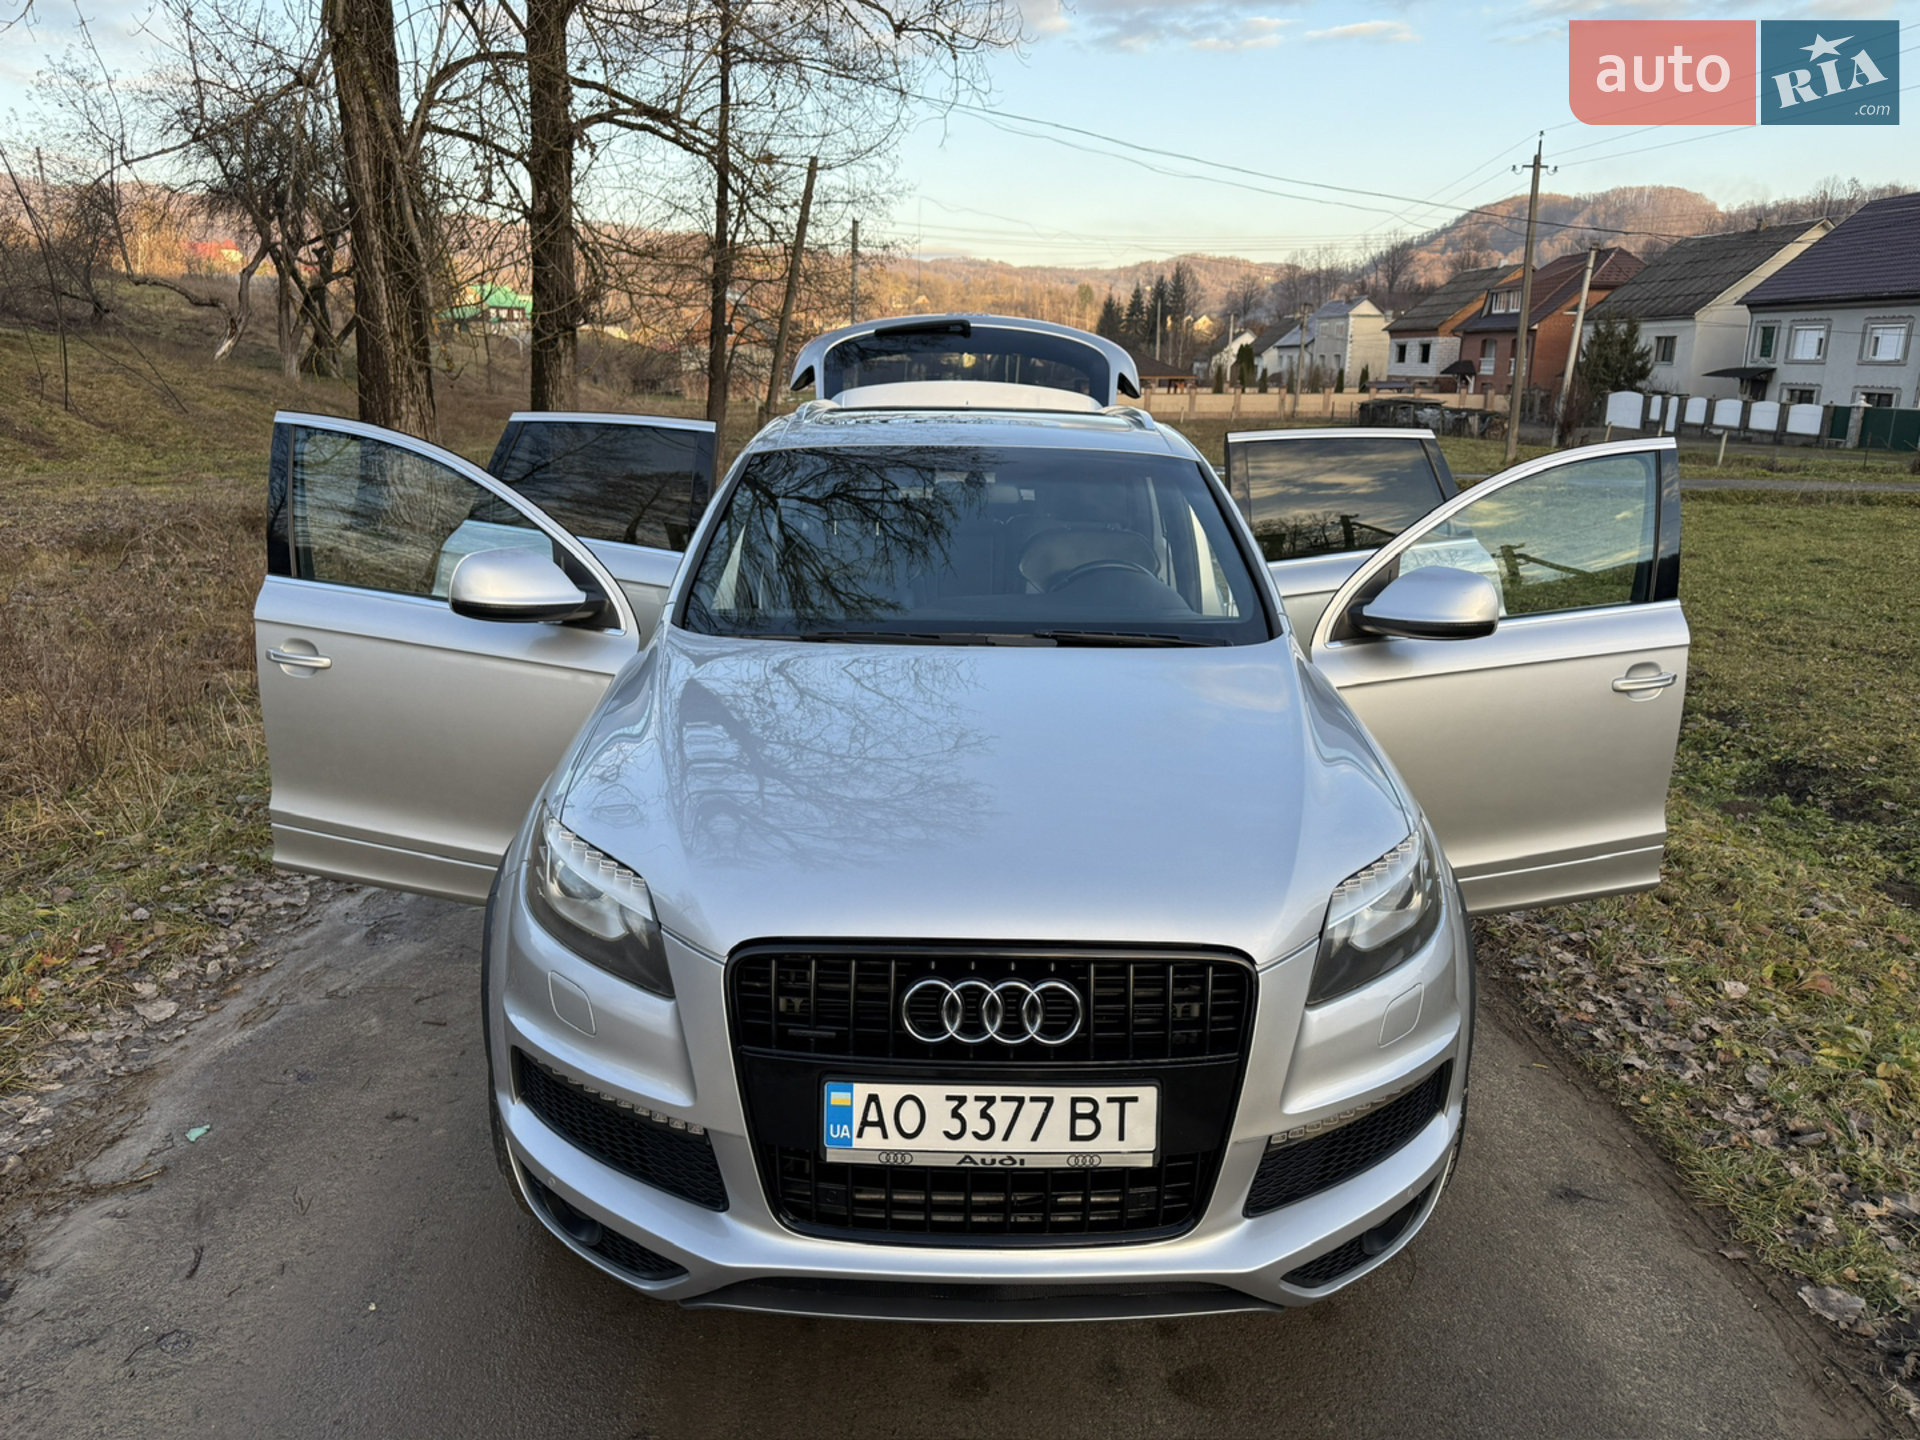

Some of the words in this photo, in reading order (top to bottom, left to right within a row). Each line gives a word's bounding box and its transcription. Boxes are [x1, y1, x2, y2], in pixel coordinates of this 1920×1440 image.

[856, 1093, 927, 1140] AO
[942, 1095, 1055, 1142] 3377
[1069, 1096, 1140, 1142] BT
[829, 1124, 851, 1139] UA
[955, 1154, 1026, 1167] Audi
